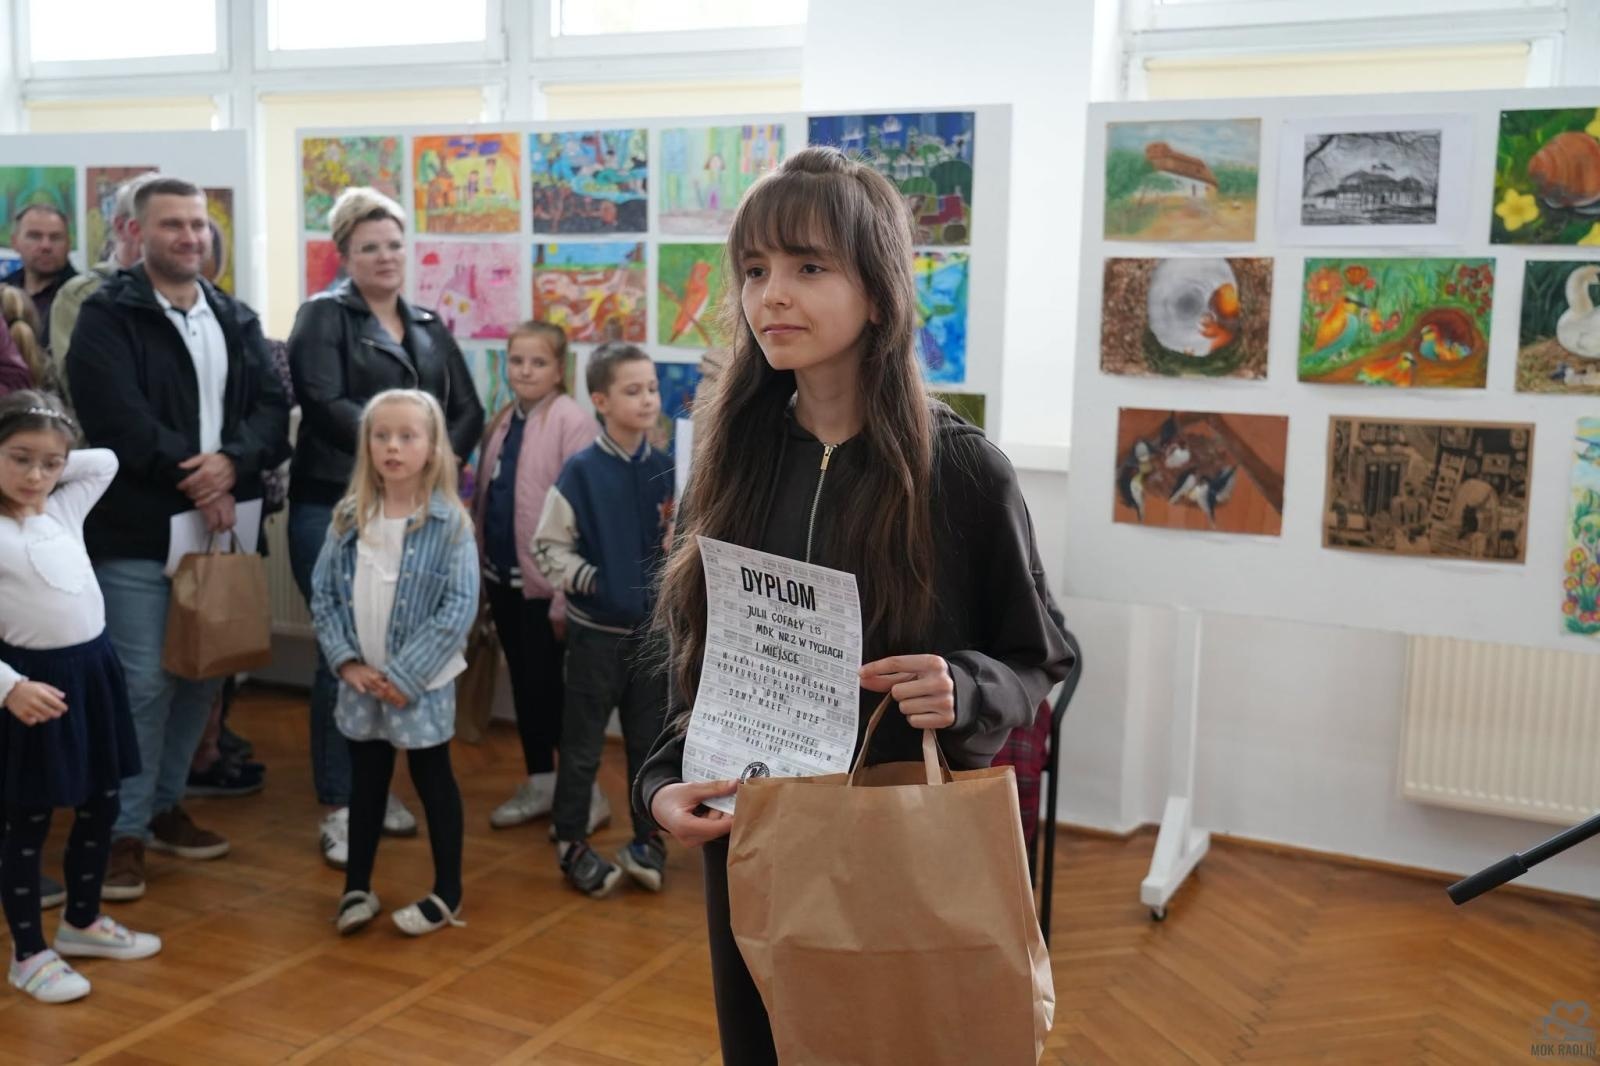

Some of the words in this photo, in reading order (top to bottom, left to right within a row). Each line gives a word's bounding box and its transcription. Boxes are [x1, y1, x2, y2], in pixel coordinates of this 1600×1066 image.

[741, 566, 816, 611] DYPLOM
[747, 605, 767, 619] JULII
[772, 612, 804, 630] COFAŁY
[756, 624, 774, 638] MDK
[799, 637, 807, 647] W
[809, 640, 843, 659] TYCHACH
[762, 644, 799, 664] MIEJSCE
